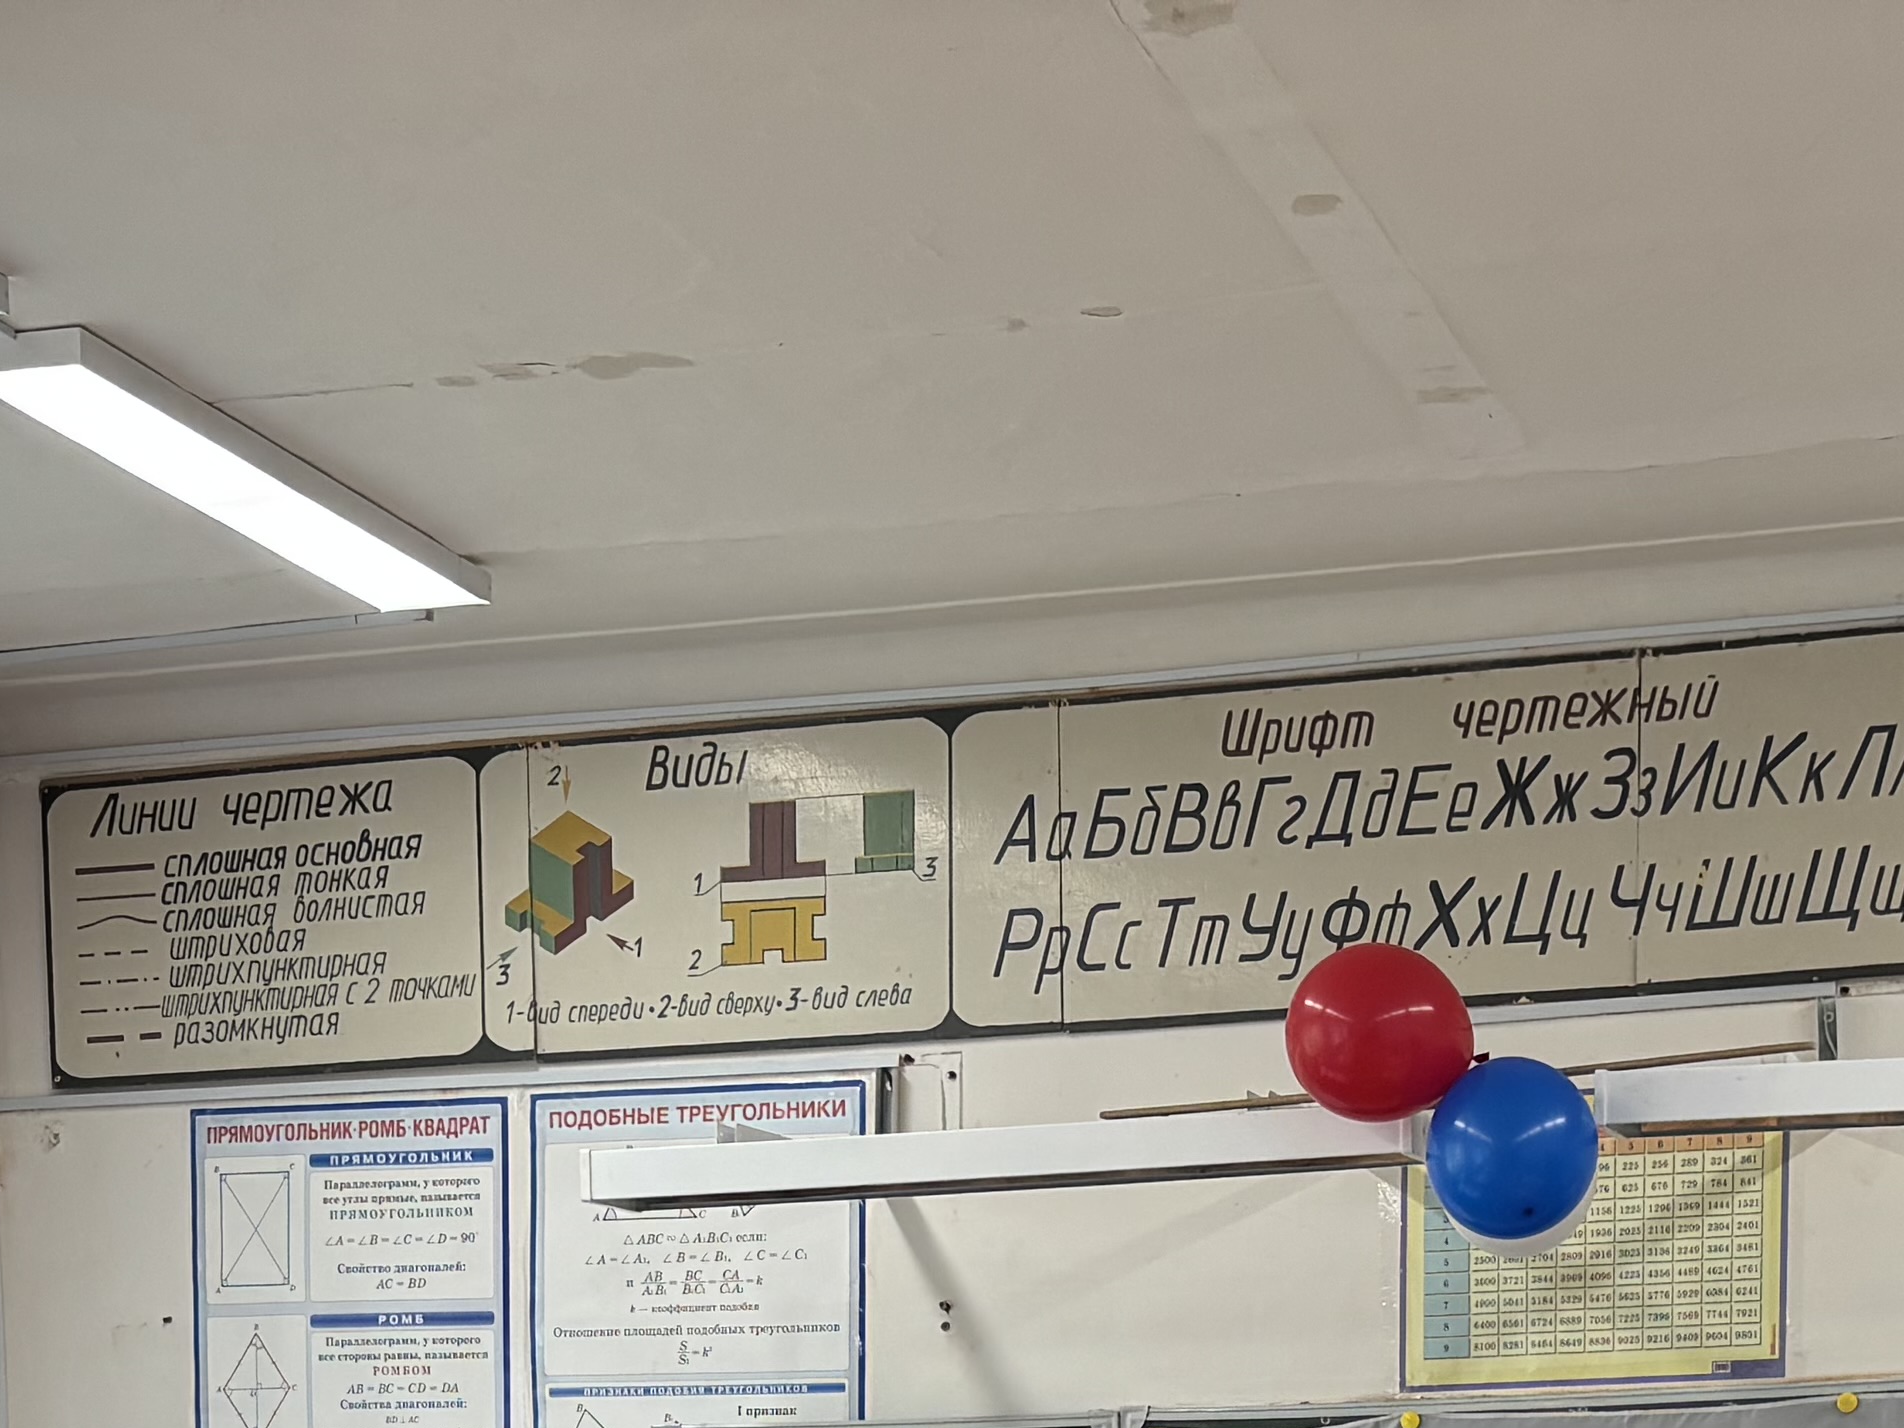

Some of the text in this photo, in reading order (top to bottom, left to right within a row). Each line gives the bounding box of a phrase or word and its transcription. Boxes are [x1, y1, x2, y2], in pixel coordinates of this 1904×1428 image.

[1221, 674, 1718, 763] Шрифт чертежный
[547, 765, 560, 786] 2
[646, 741, 749, 790] Виды
[90, 779, 392, 837] Линии чертежа
[164, 829, 422, 878] сплошная основная
[923, 856, 936, 877] 3
[161, 865, 388, 905] сплошная тонкая
[694, 873, 702, 892] 1
[163, 891, 426, 933] сплошная волнистая
[170, 927, 306, 960] штриховая
[634, 937, 642, 957] 1
[688, 949, 702, 970] 2
[169, 951, 387, 990] штрихпунктирная
[497, 964, 509, 985] 3
[161, 982, 337, 1018] штрихпунктирная
[365, 979, 378, 1005] 2
[389, 973, 476, 1001] точками
[568, 996, 643, 1023] спереди
[717, 993, 775, 1018] сверху
[856, 984, 912, 1007] слева
[174, 1011, 340, 1049] разомкнутая
[549, 1100, 846, 1129] ПОДОБНЫЕ ТРЕУГОЛЬНИКИ
[330, 1151, 473, 1166] ПРЯМОУГОЛЬНИК
[378, 1314, 424, 1324] РОМБ
